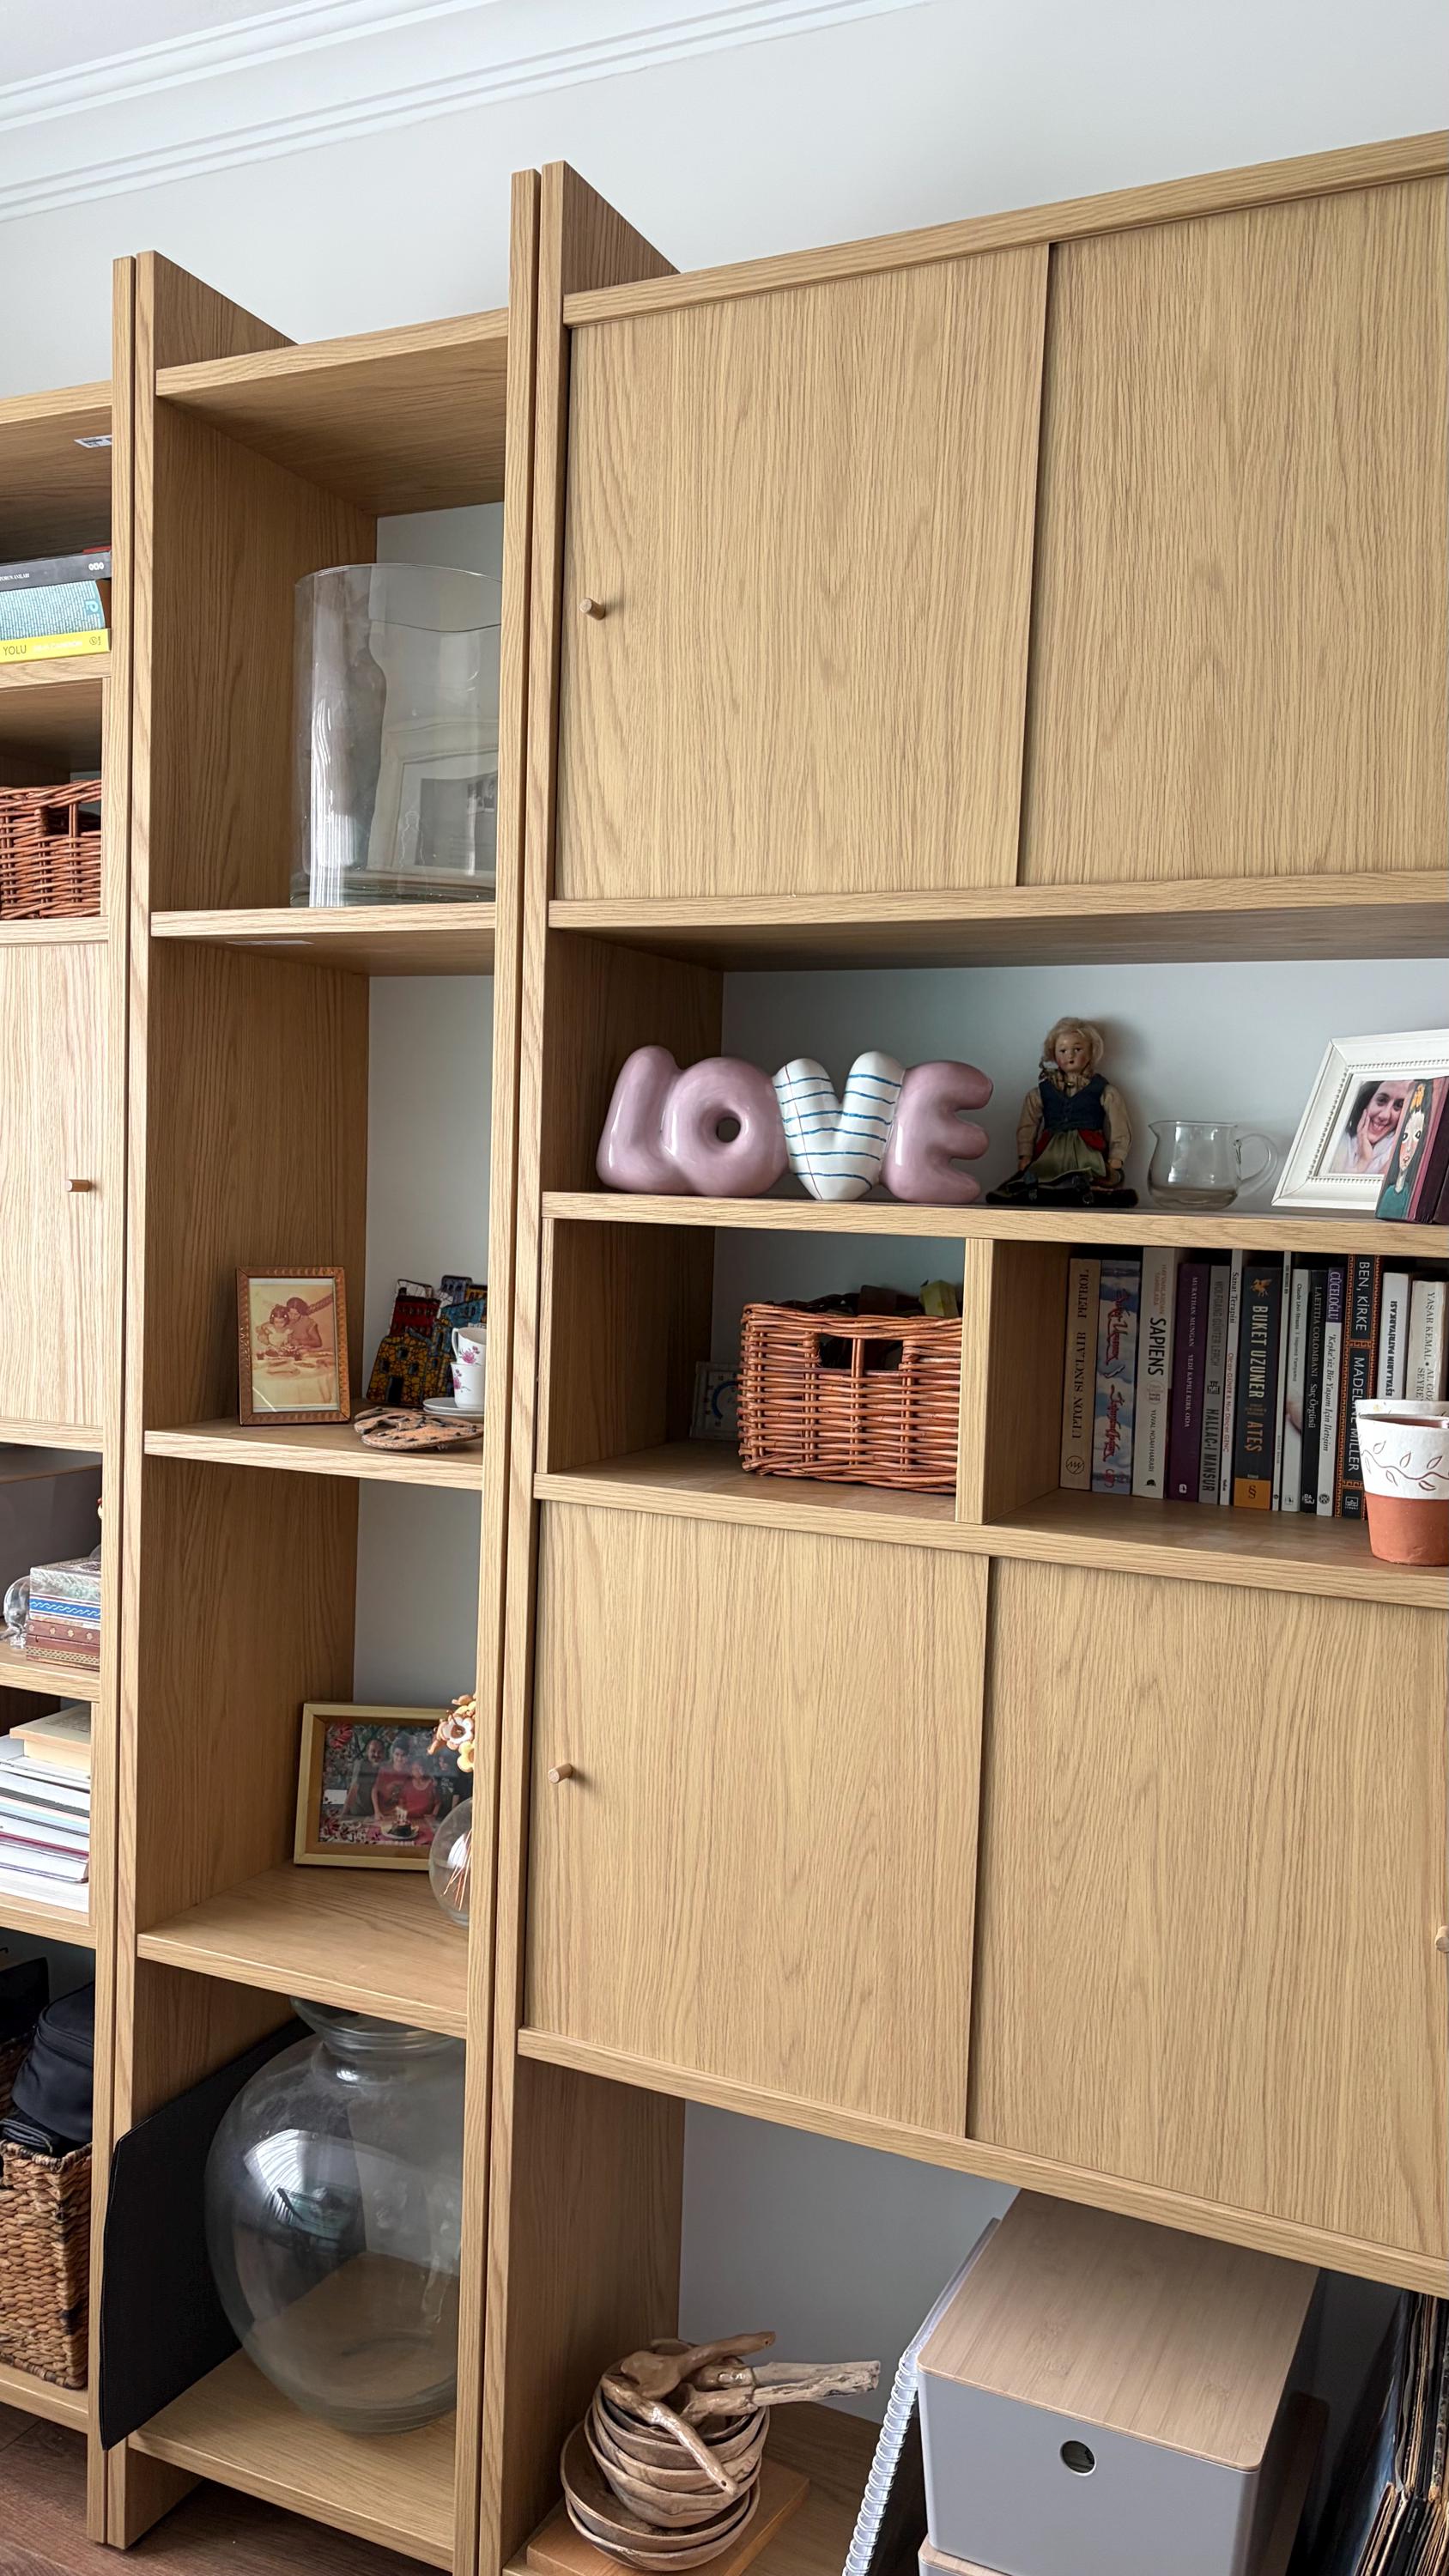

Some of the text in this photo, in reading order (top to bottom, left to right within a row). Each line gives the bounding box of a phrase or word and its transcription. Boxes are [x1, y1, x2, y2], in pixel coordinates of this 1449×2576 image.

[3, 645, 27, 656] YOLU
[596, 1045, 993, 1202] LOVE
[1190, 1277, 1198, 1315] MURATHAN
[1229, 1295, 1239, 1323] Terapisi
[1328, 1272, 1342, 1321] CÜCELOĞLU
[1355, 1261, 1370, 1331] BEN, KİRKE
[1210, 1281, 1223, 1367] WOLFGANG GÜNTER LERCH
[1251, 1306, 1268, 1346] BUKET
[1424, 1292, 1436, 1360] YAŞAR KEMAL
[1072, 1269, 1089, 1438] UPTON SINCLAIR PETROL
[1148, 1317, 1167, 1376] SAPIENS
[1307, 1287, 1322, 1428] LAETITIA COLOMBANI Saç Örgüsü
[1386, 1301, 1397, 1396] EŞYALARIN PATRİYARKASI
[1249, 1351, 1267, 1398] UZUNER
[1324, 1382, 1335, 1406] Yaşam
[1325, 1370, 1335, 1381] Bir
[1427, 1369, 1434, 1381] AL
[1323, 1409, 1333, 1422] İçin
[1245, 1421, 1264, 1453] ATEŞ
[1322, 1425, 1332, 1451] İletişim
[1348, 1429, 1360, 1472] MILLER
[1202, 1454, 1217, 1492] MANSUR
